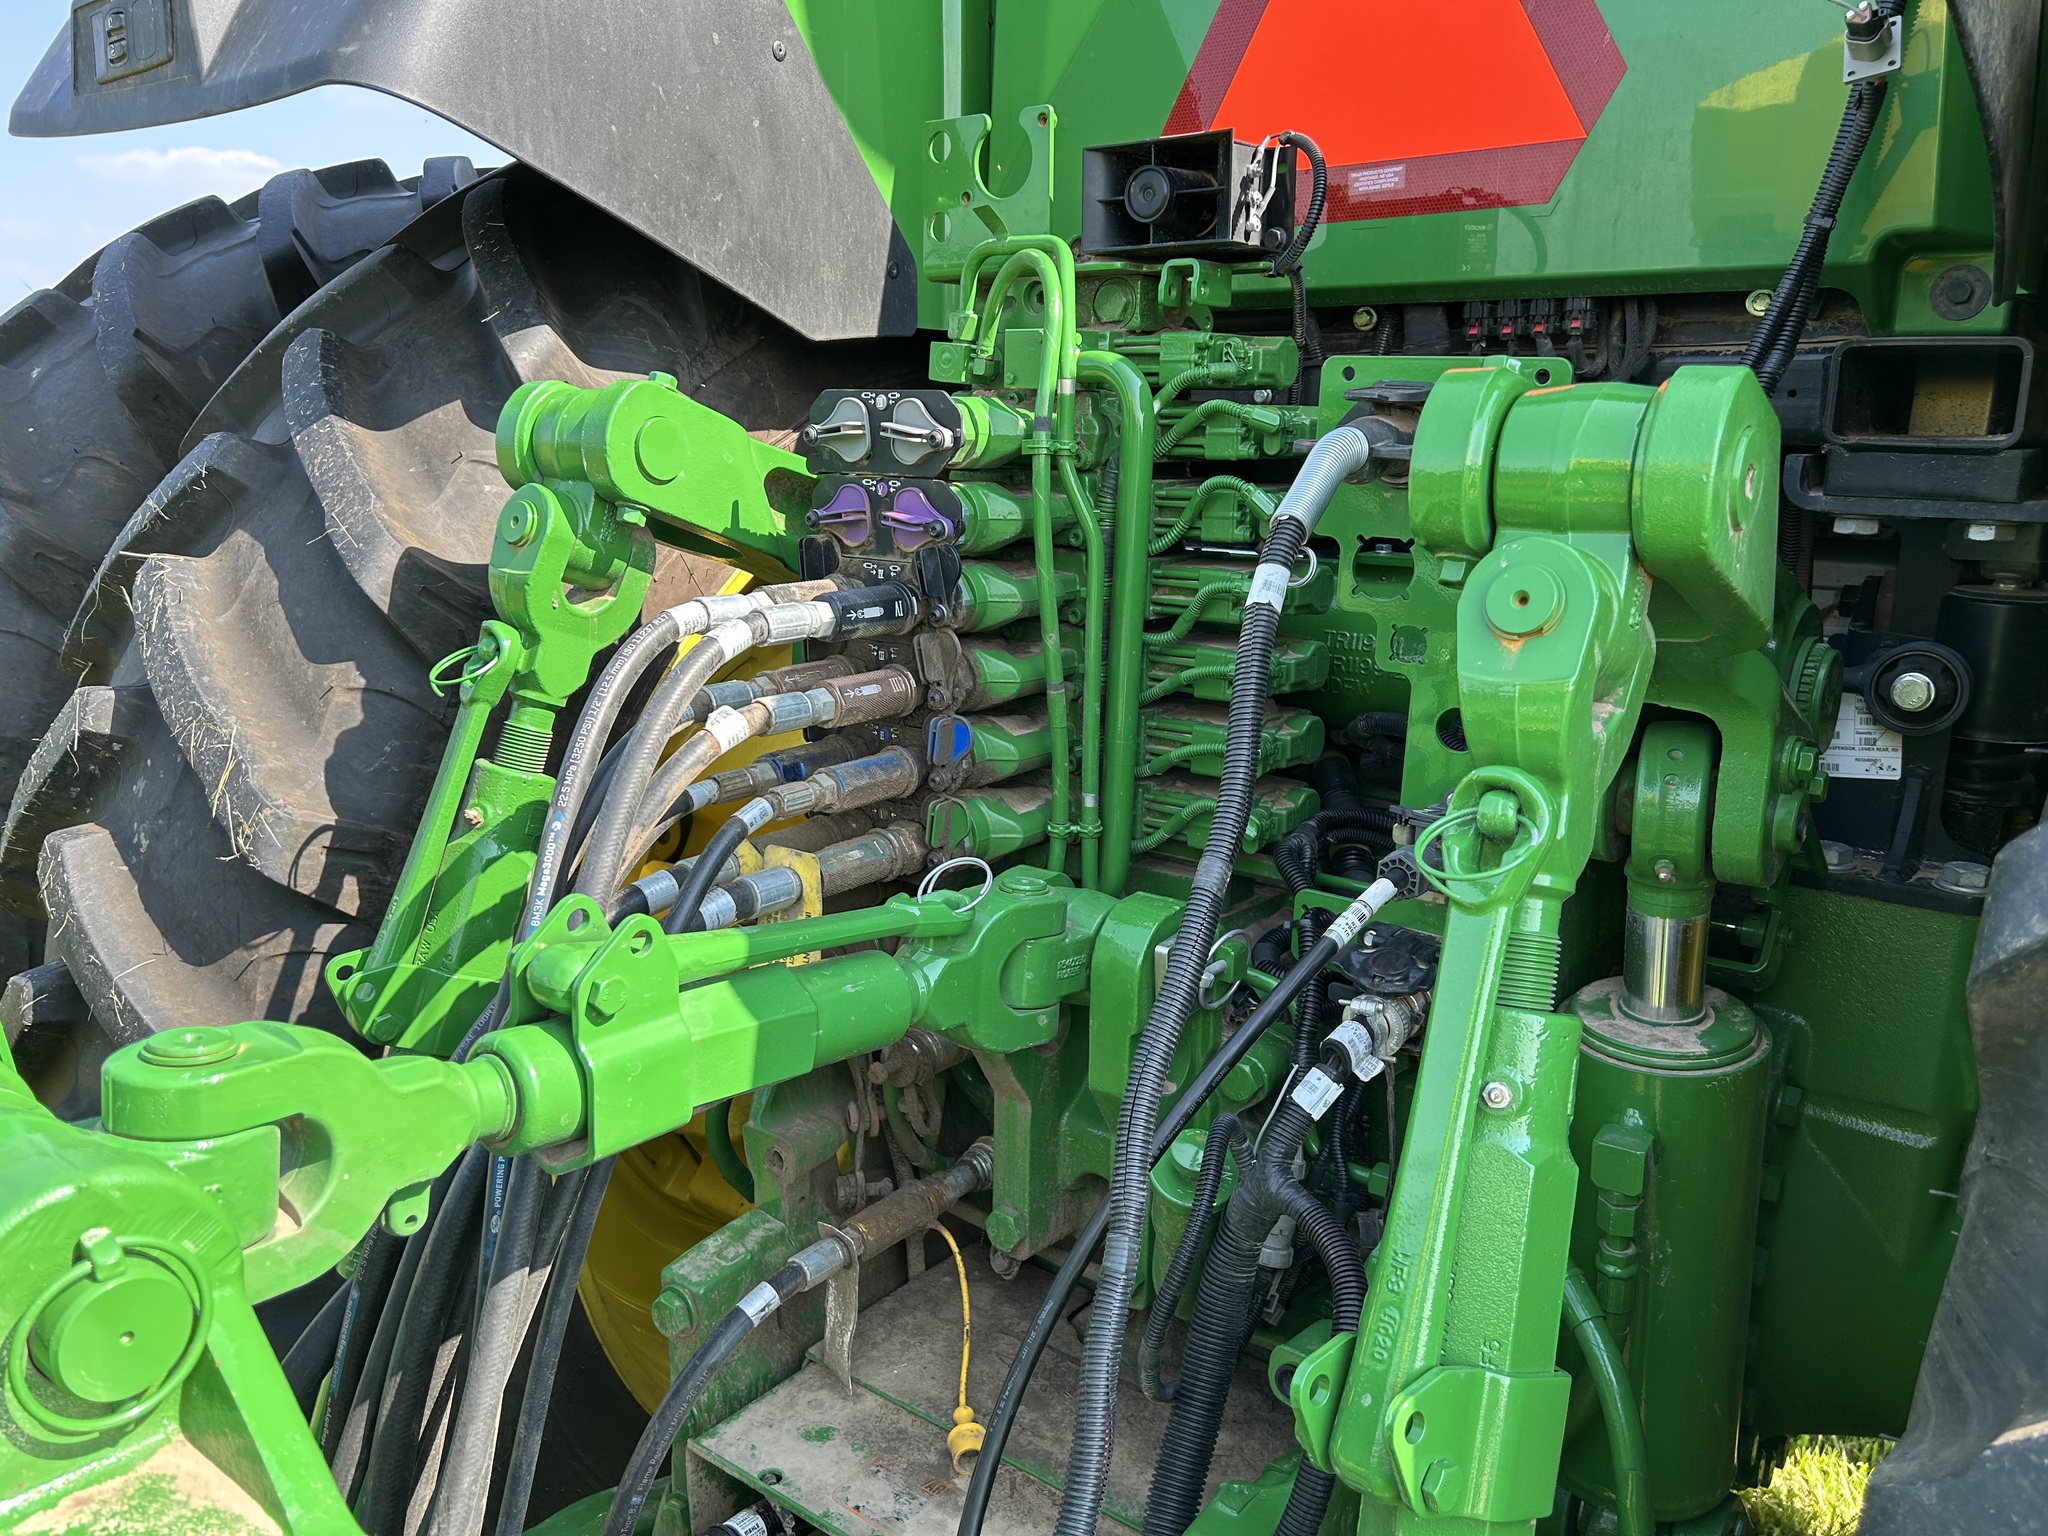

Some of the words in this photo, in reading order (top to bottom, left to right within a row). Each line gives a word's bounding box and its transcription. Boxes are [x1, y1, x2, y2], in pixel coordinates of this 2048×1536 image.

[632, 624, 654, 644] 11237
[622, 642, 636, 658] ISO
[610, 655, 628, 675] mm)
[597, 675, 614, 696] (12.5
[570, 736, 587, 763] (3250
[564, 764, 577, 784] MPa
[557, 786, 571, 807] 22.5
[530, 898, 545, 927] 8M3K
[462, 1032, 476, 1050] SAE
[494, 1164, 505, 1208] POWERING
[671, 1402, 690, 1426] MSHA
